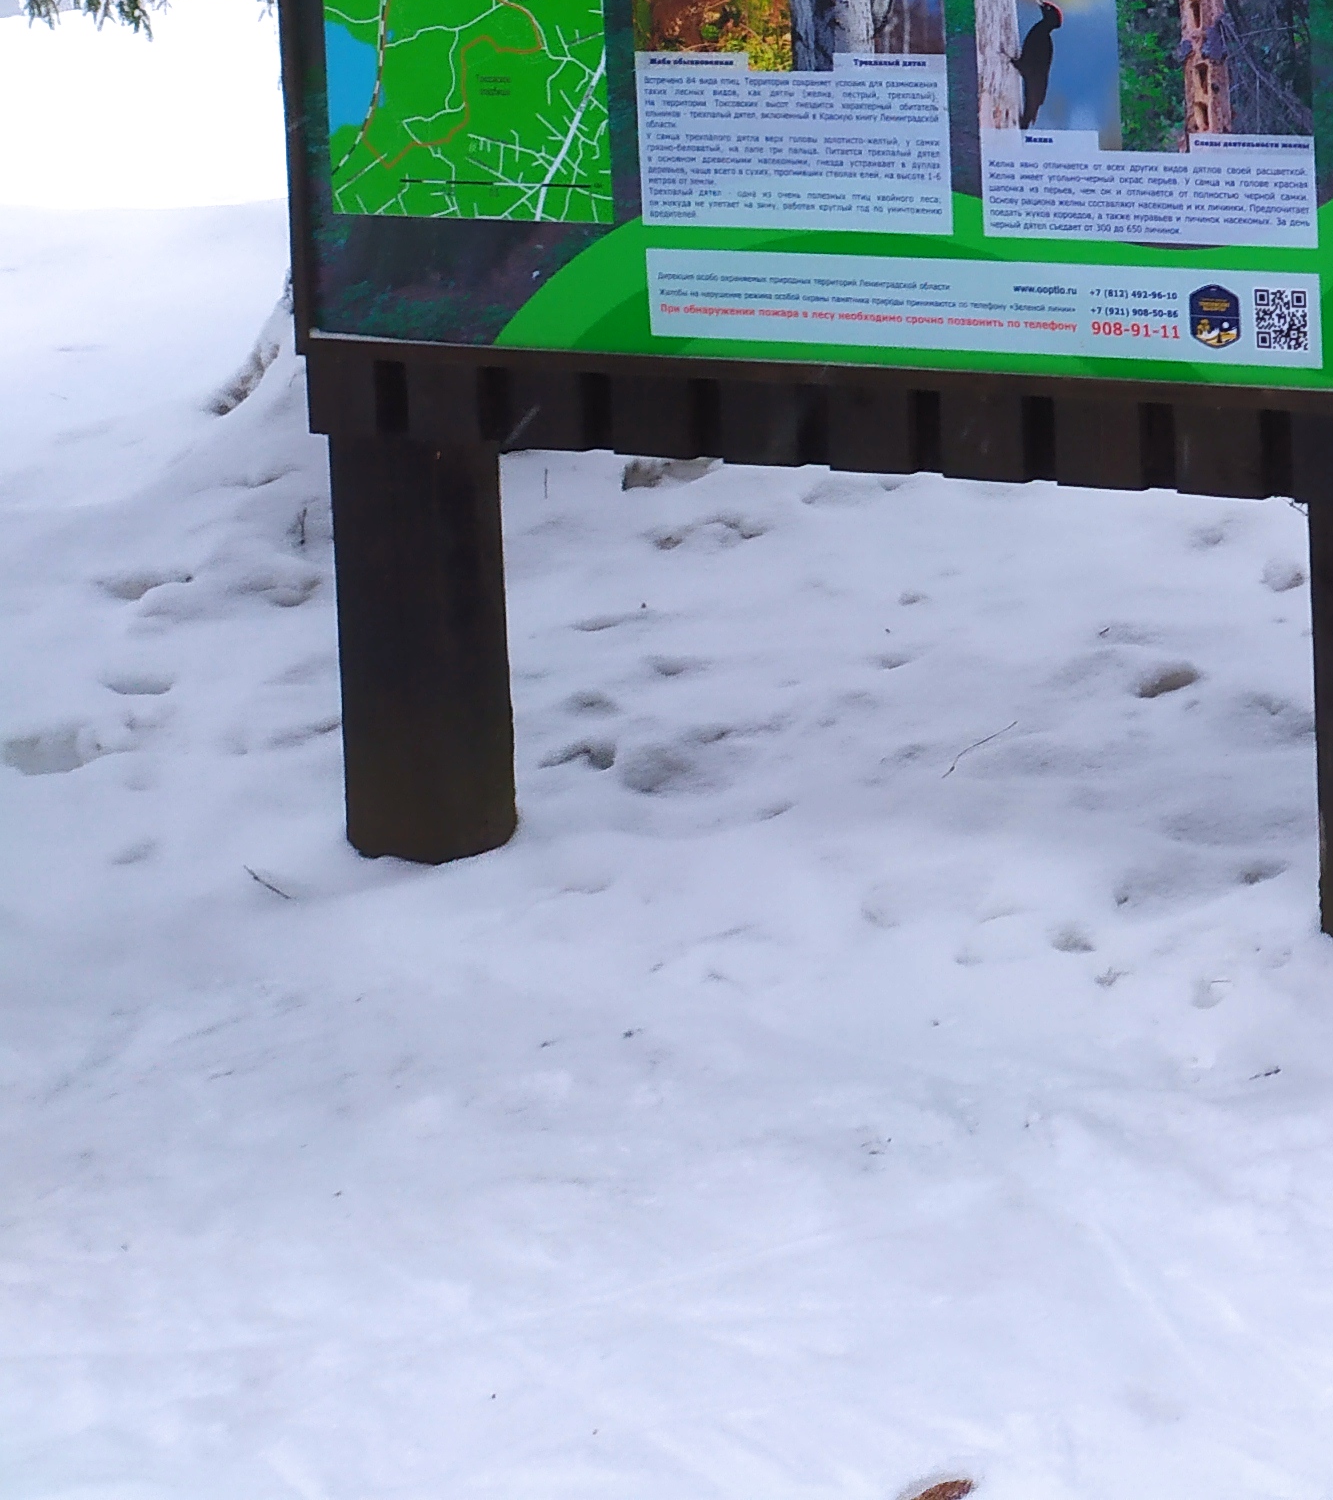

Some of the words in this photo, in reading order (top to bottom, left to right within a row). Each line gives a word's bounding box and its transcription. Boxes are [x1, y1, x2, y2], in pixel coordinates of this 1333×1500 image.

[1089, 288, 1101, 296] +7
[1103, 288, 1128, 299] (812)
[1130, 290, 1177, 300] 492-96-10
[659, 303, 681, 314] При
[682, 304, 755, 317] обнаружении
[757, 308, 800, 318] пожара
[801, 310, 809, 318] в
[810, 311, 836, 321] лесу
[837, 311, 903, 323] необходимо
[904, 315, 944, 325] срочно
[946, 317, 1004, 327] позвонить
[1006, 319, 1021, 328] по
[1022, 319, 1077, 332] телефону
[1091, 320, 1180, 339] 908-91-11
